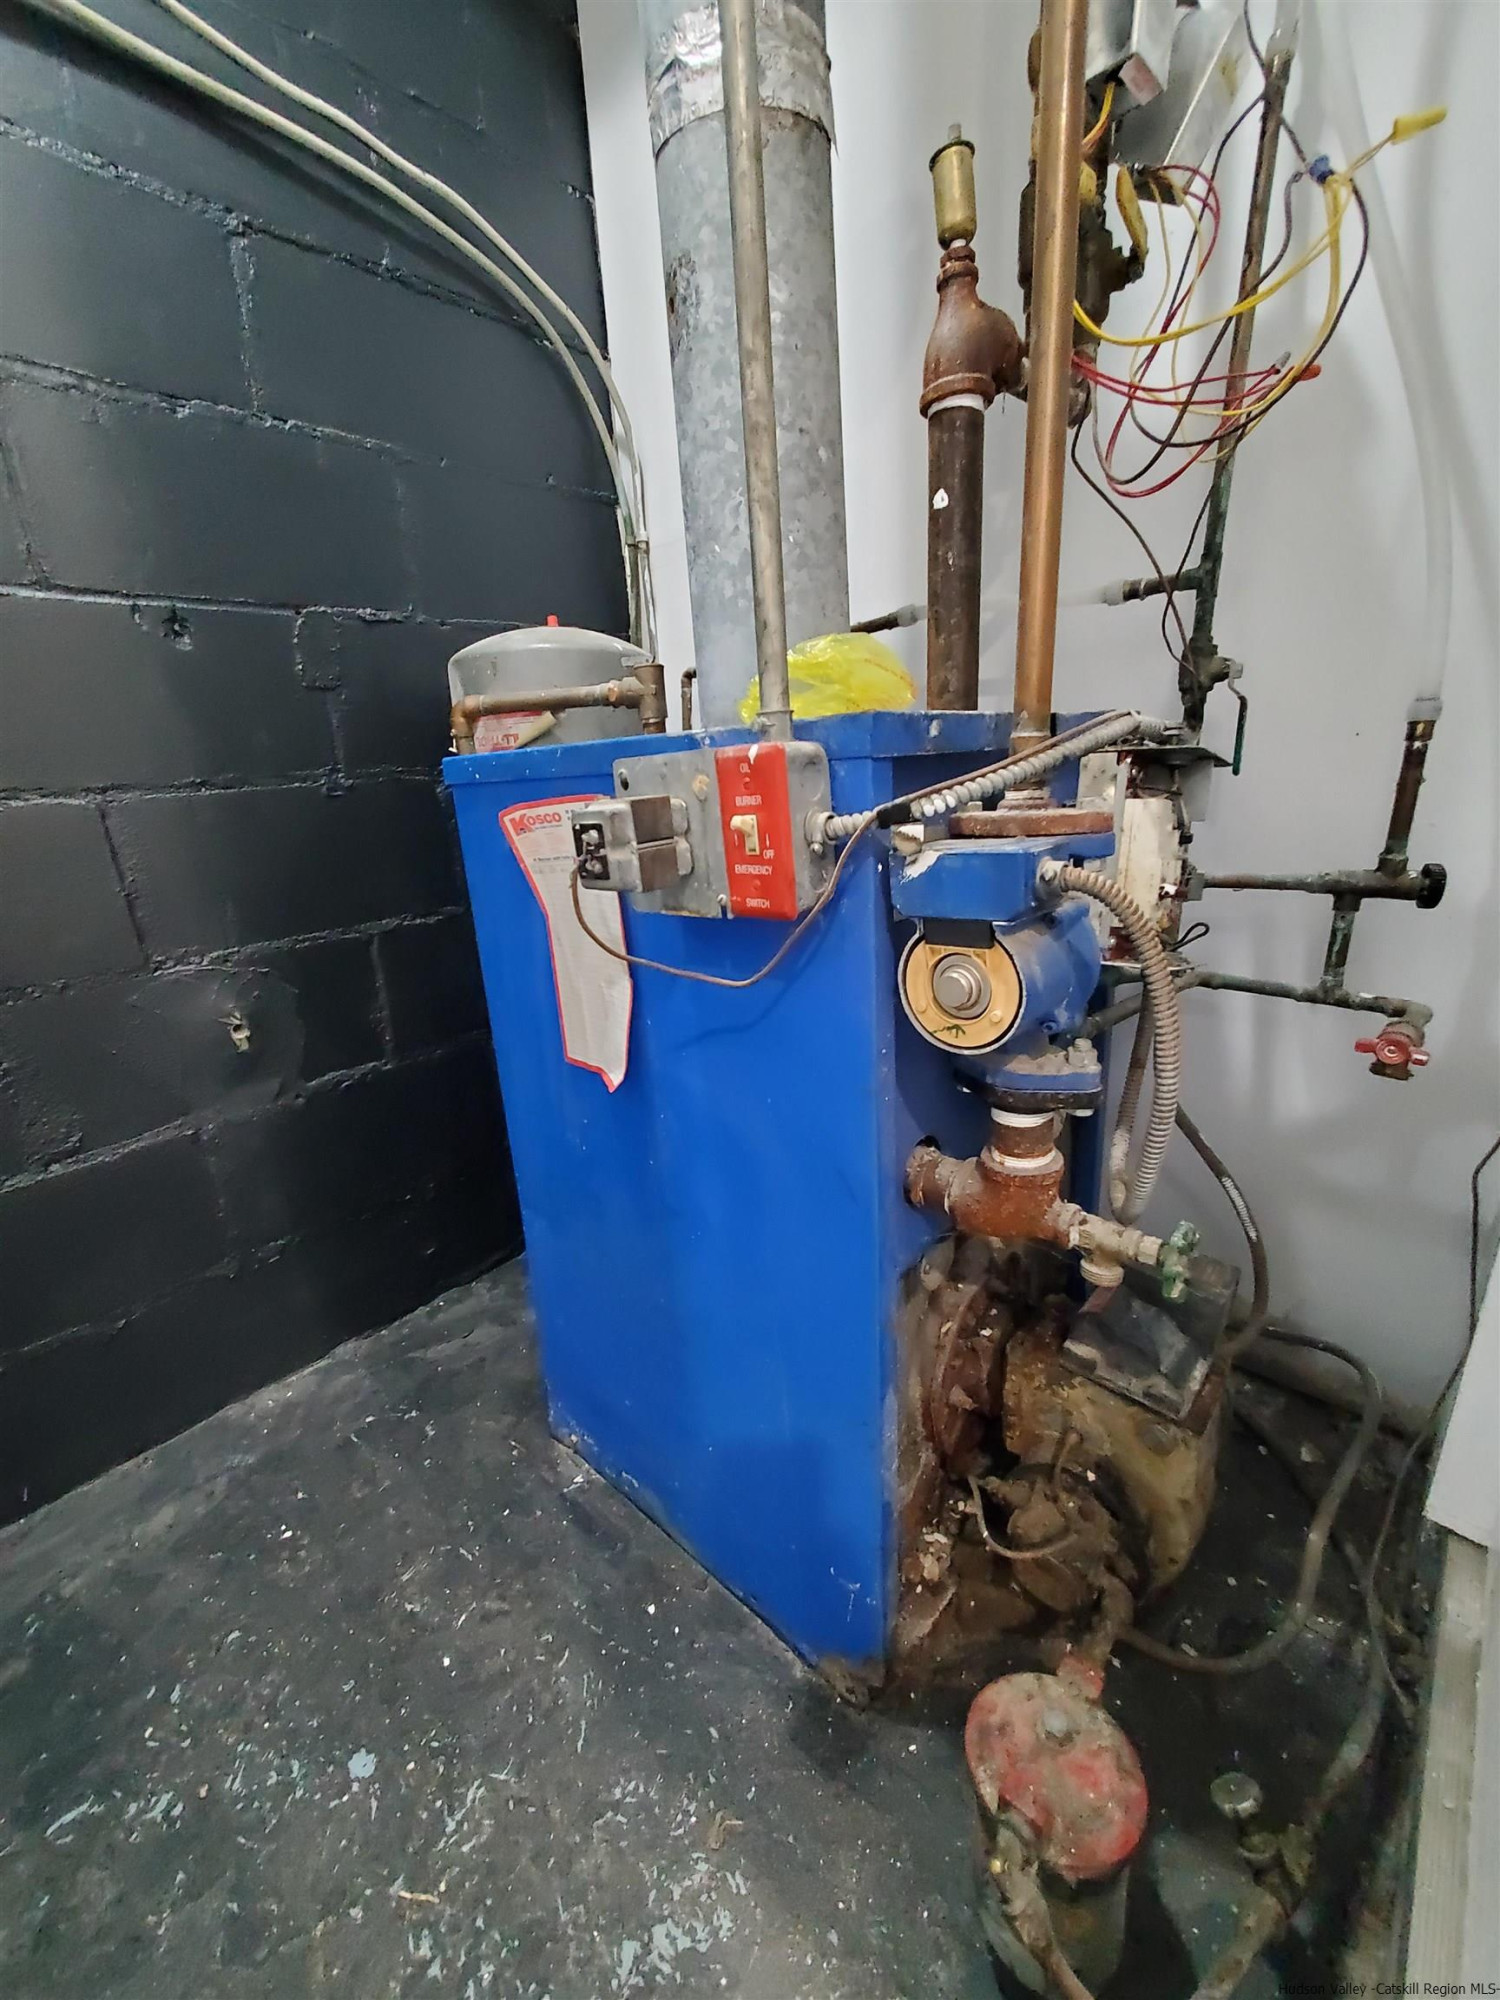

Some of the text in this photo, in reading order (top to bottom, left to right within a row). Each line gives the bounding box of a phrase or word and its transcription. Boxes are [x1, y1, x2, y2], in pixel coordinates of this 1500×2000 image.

[740, 763, 751, 773] OIL
[735, 795, 762, 807] BURNER
[508, 812, 562, 836] KOSCO
[763, 849, 775, 859] OFF
[734, 864, 773, 875] EMERGENCY
[745, 897, 771, 908] SWITCH
